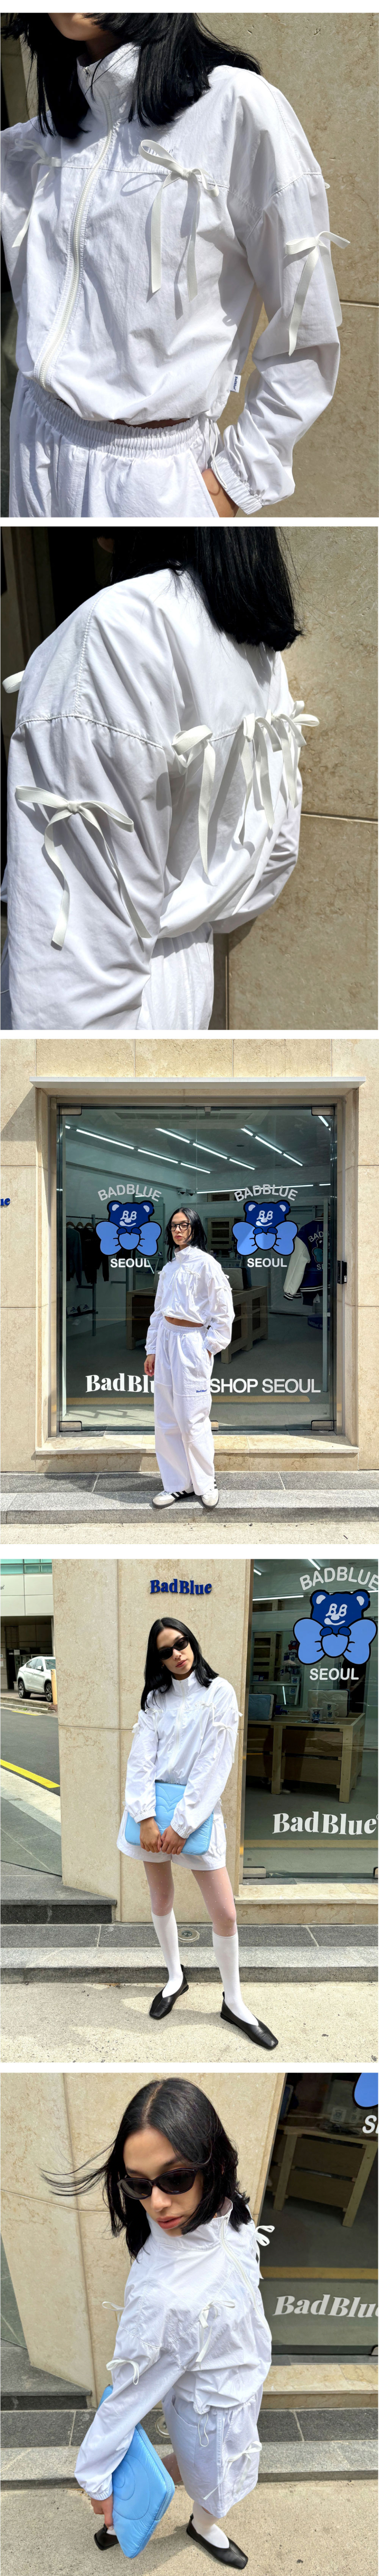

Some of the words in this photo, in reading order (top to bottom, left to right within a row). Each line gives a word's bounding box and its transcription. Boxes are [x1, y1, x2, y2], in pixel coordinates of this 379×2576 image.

[98, 1184, 162, 1202] BADBLUE
[234, 1184, 298, 1202] BADBLUE
[110, 1258, 150, 1268] SEOUL
[247, 1258, 287, 1267] SEOUL
[210, 1378, 258, 1393] SHOP
[262, 1378, 321, 1393] SEOUL
[150, 1578, 212, 1595] BadBlue
[300, 1566, 378, 1591] BADBLUE
[310, 1668, 359, 1681] SEOUL
[362, 2115, 378, 2134] S
